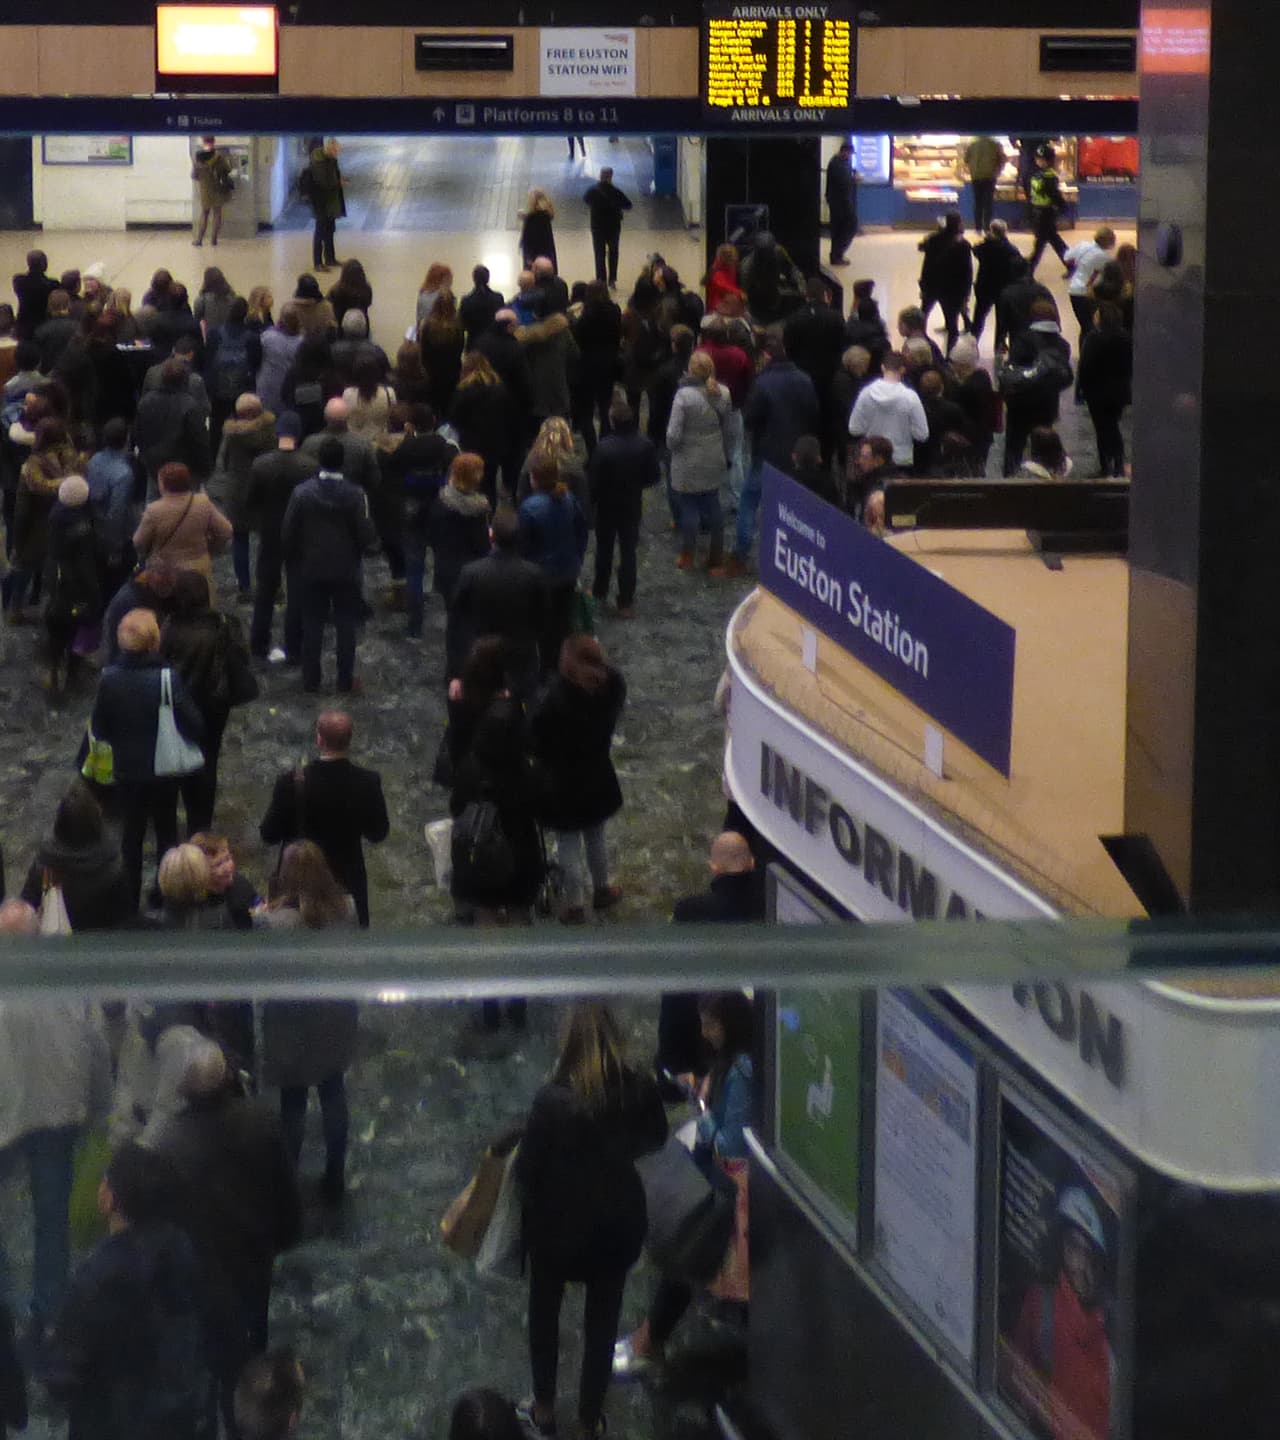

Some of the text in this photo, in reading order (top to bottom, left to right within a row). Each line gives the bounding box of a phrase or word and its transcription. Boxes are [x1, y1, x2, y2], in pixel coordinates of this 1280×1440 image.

[732, 6, 828, 17] ARRIVALS ONLY
[546, 48, 628, 59] FREE EUSTON
[547, 64, 628, 75] STATION WiFi
[483, 106, 619, 122] Platforms 8 to 11
[731, 109, 826, 120] ARRIVALS ONLY
[778, 502, 826, 551] Welcome to
[774, 527, 929, 680] Euston Station
[761, 741, 1124, 1088] INFORMON
